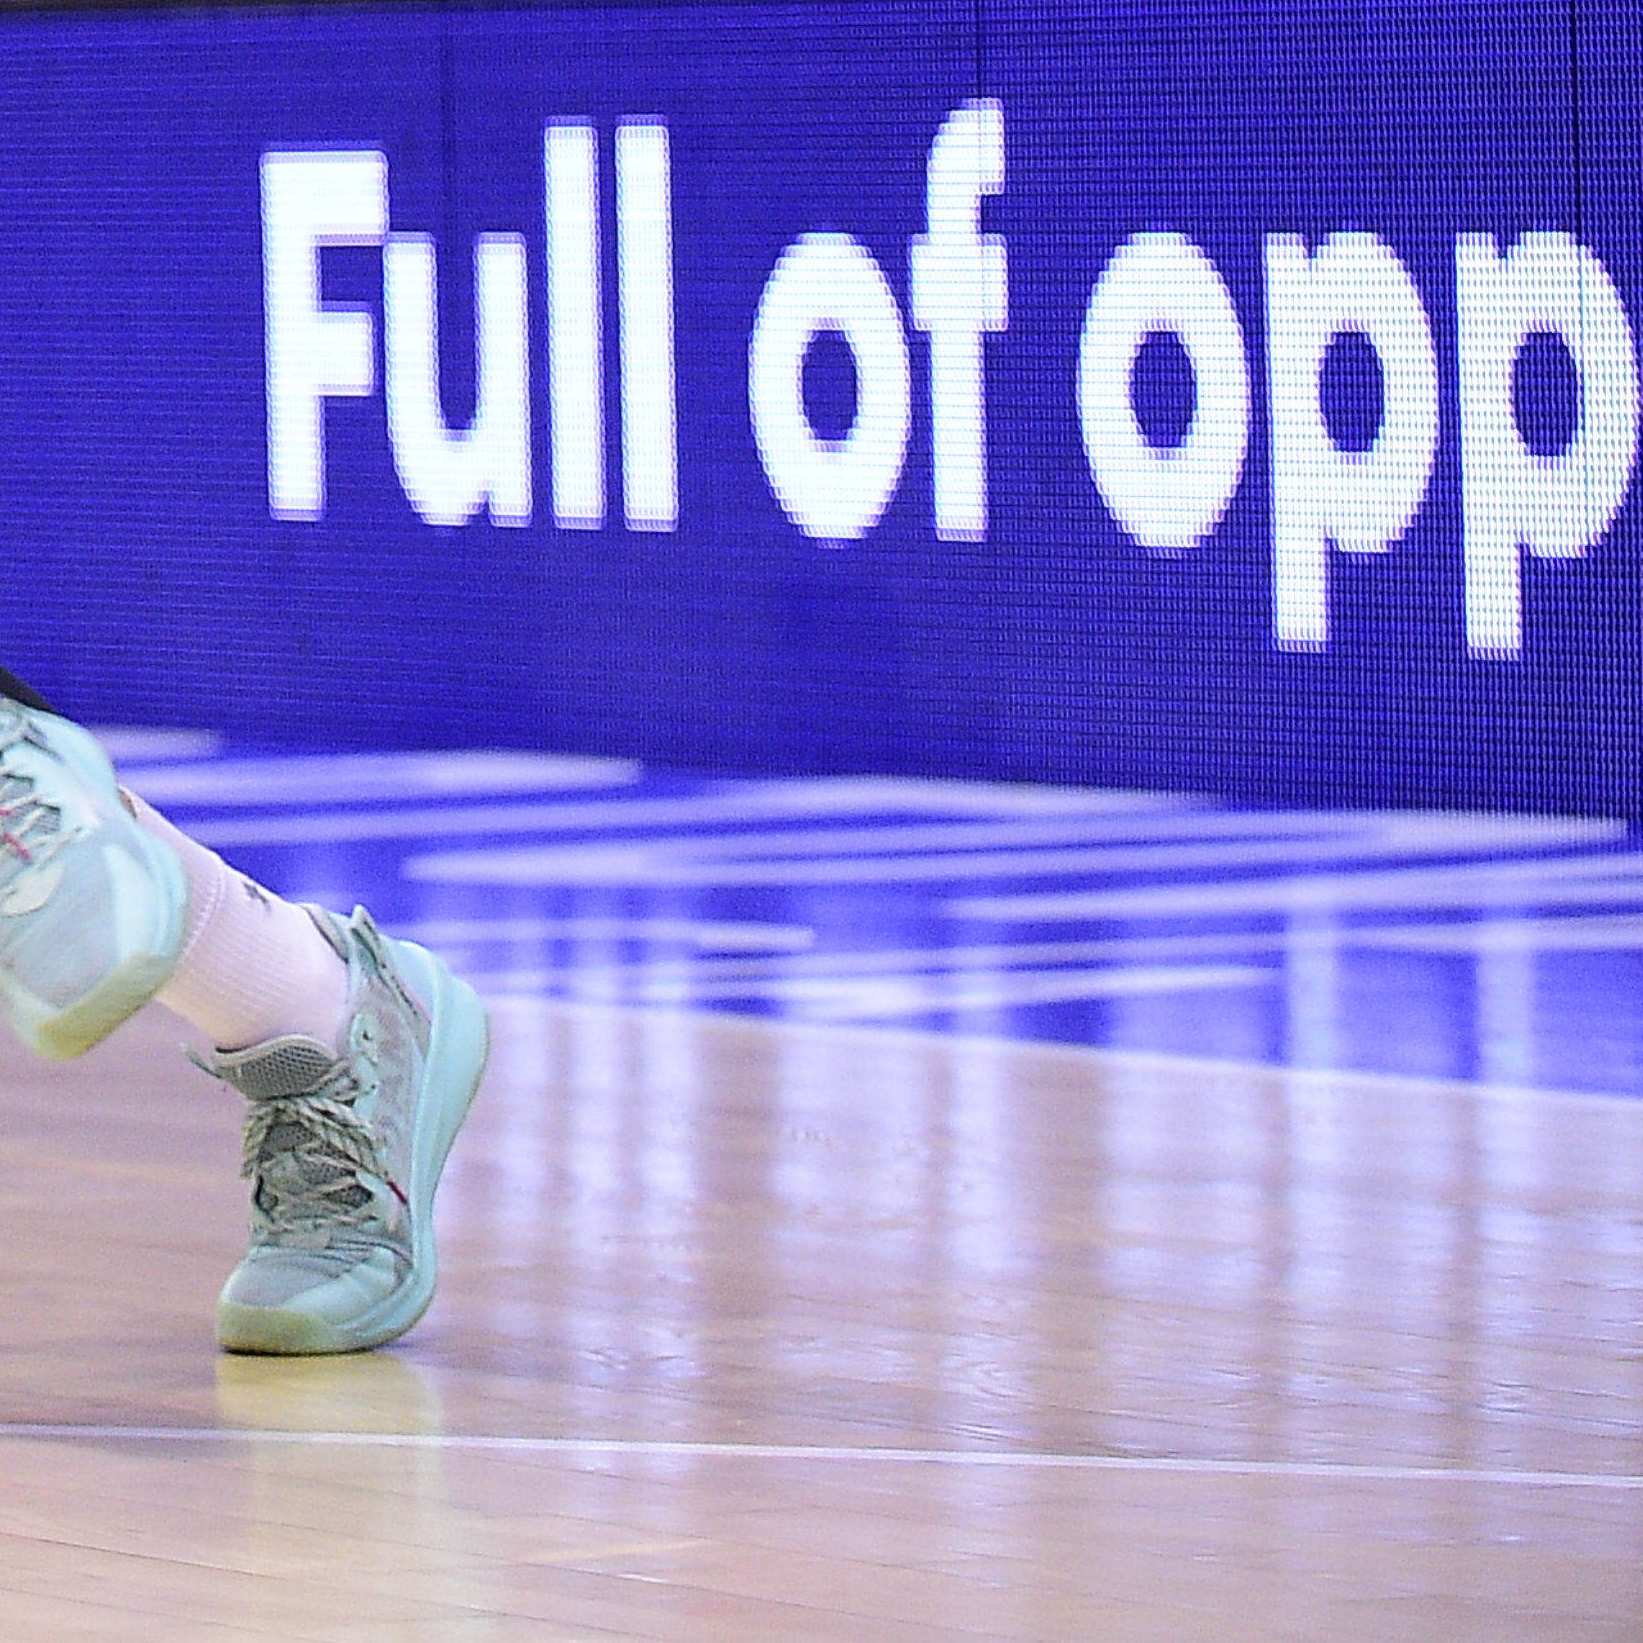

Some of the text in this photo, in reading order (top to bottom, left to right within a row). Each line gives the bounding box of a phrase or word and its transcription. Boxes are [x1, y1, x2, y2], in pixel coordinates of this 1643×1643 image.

[260, 96, 1642, 661] Full of opp
